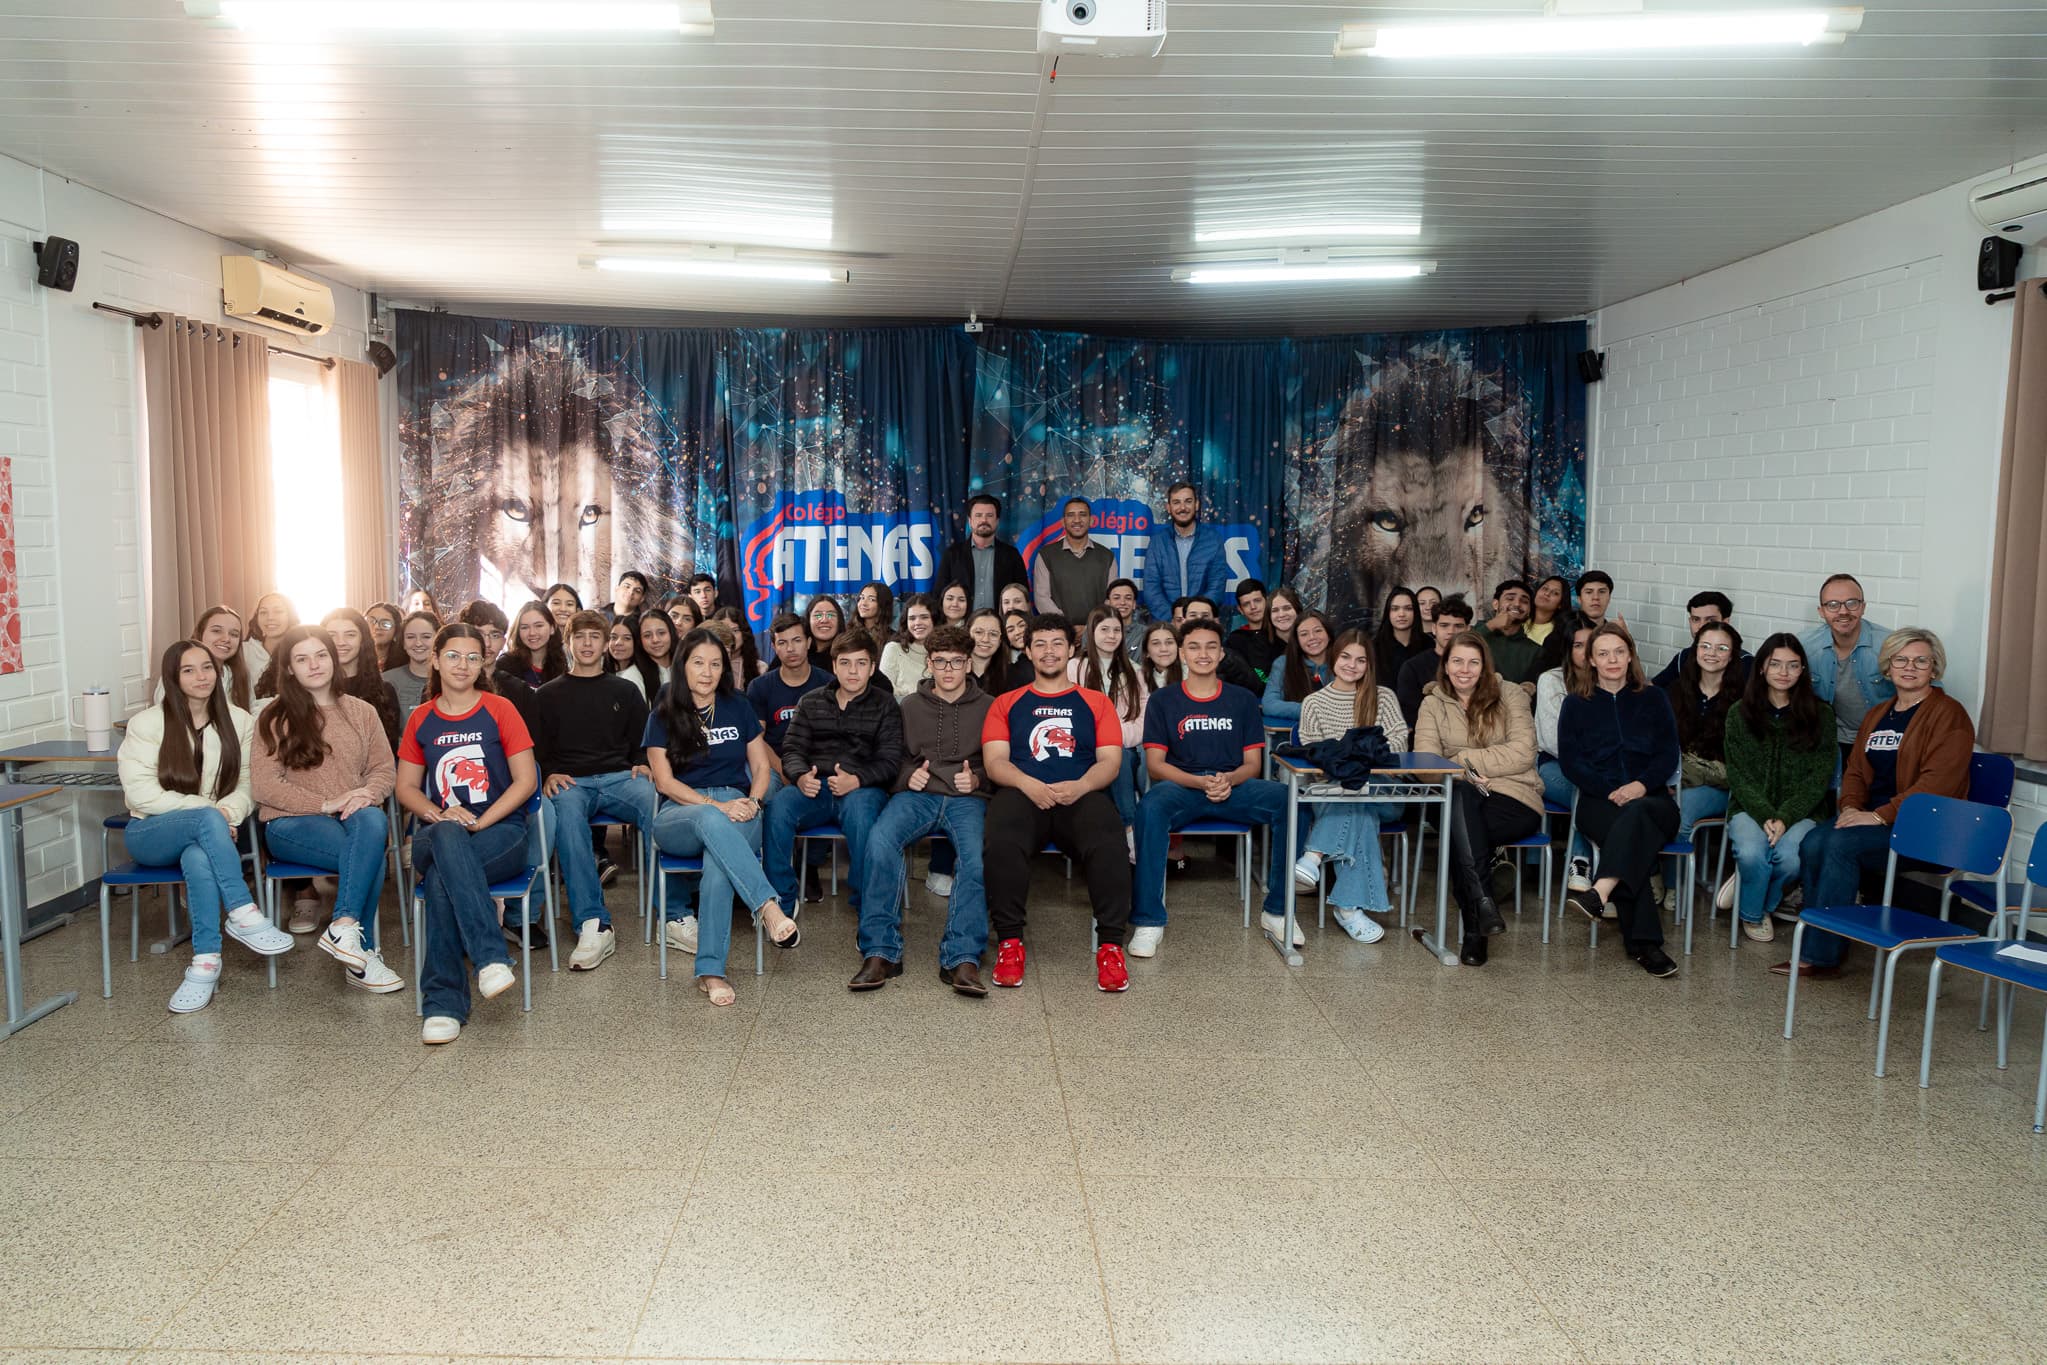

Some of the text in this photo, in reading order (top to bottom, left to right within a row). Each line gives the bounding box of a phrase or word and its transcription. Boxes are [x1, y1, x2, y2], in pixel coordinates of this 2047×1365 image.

[1090, 511, 1148, 534] olégio
[772, 524, 934, 590] ATENAS
[1035, 708, 1072, 716] ATENAS
[1184, 718, 1232, 731] ATENAS
[437, 732, 482, 744] ATENAS
[1870, 735, 1901, 746] ATEN
